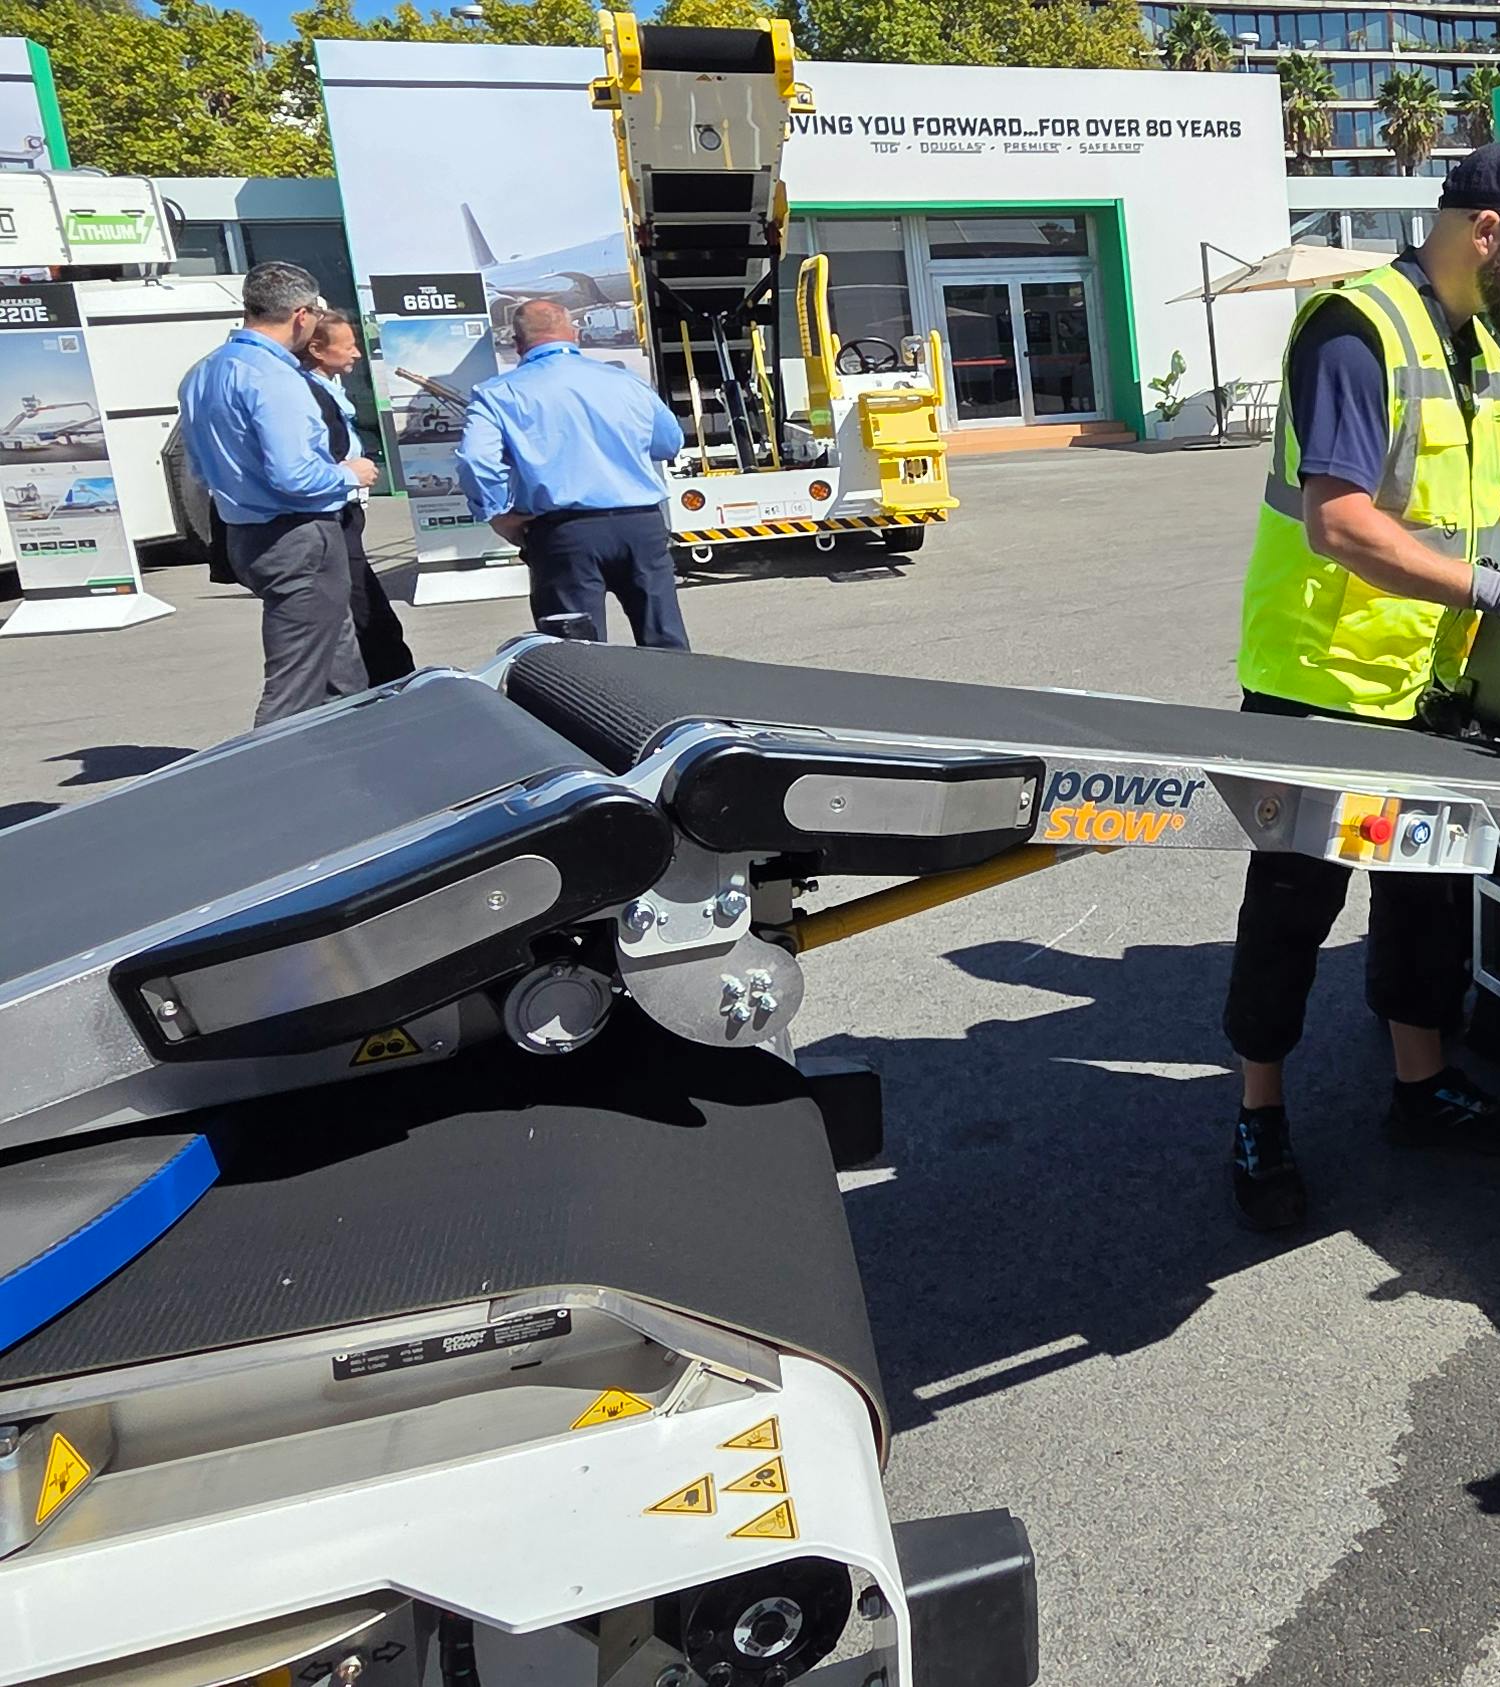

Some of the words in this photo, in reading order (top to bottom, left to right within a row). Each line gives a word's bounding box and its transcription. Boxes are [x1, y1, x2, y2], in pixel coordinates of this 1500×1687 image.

[858, 115, 905, 136] YOU
[1086, 118, 1141, 137] OVER
[1146, 119, 1172, 137] 80
[1176, 119, 1242, 138] YEARS
[870, 142, 900, 153] TUG
[920, 142, 984, 154] DOUGLAS
[1003, 142, 1061, 154] PREMIER
[1079, 142, 1144, 154] SAFEAERO
[67, 218, 137, 241] LITHIUM
[403, 294, 458, 311] 660E
[1041, 770, 1206, 812] power
[443, 1330, 487, 1348] power
